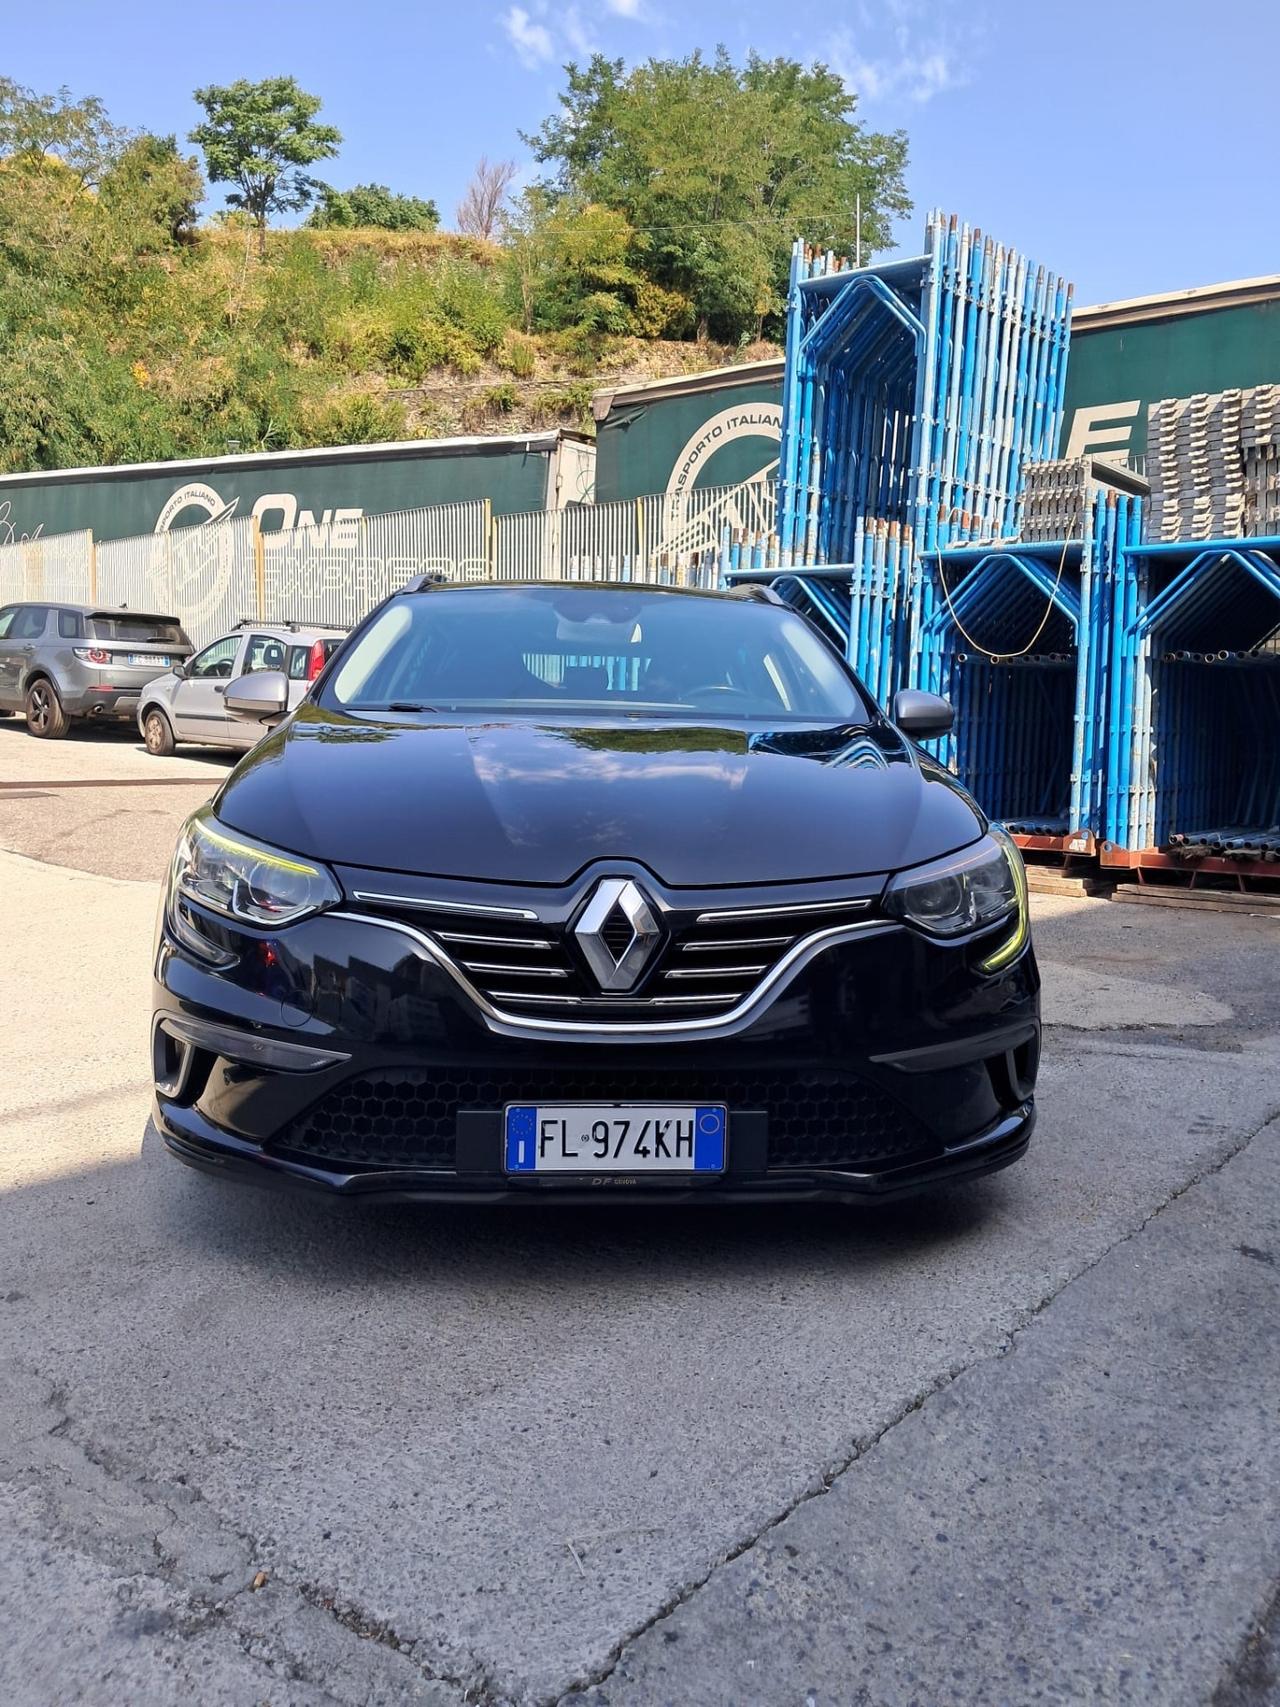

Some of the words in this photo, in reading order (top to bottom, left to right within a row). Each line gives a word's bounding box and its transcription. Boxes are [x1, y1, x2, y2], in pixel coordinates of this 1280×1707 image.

[726, 413, 782, 430] ITALIAN
[184, 489, 216, 507] ITALIANO
[539, 1119, 579, 1158] FL
[591, 1119, 694, 1158] 974KH
